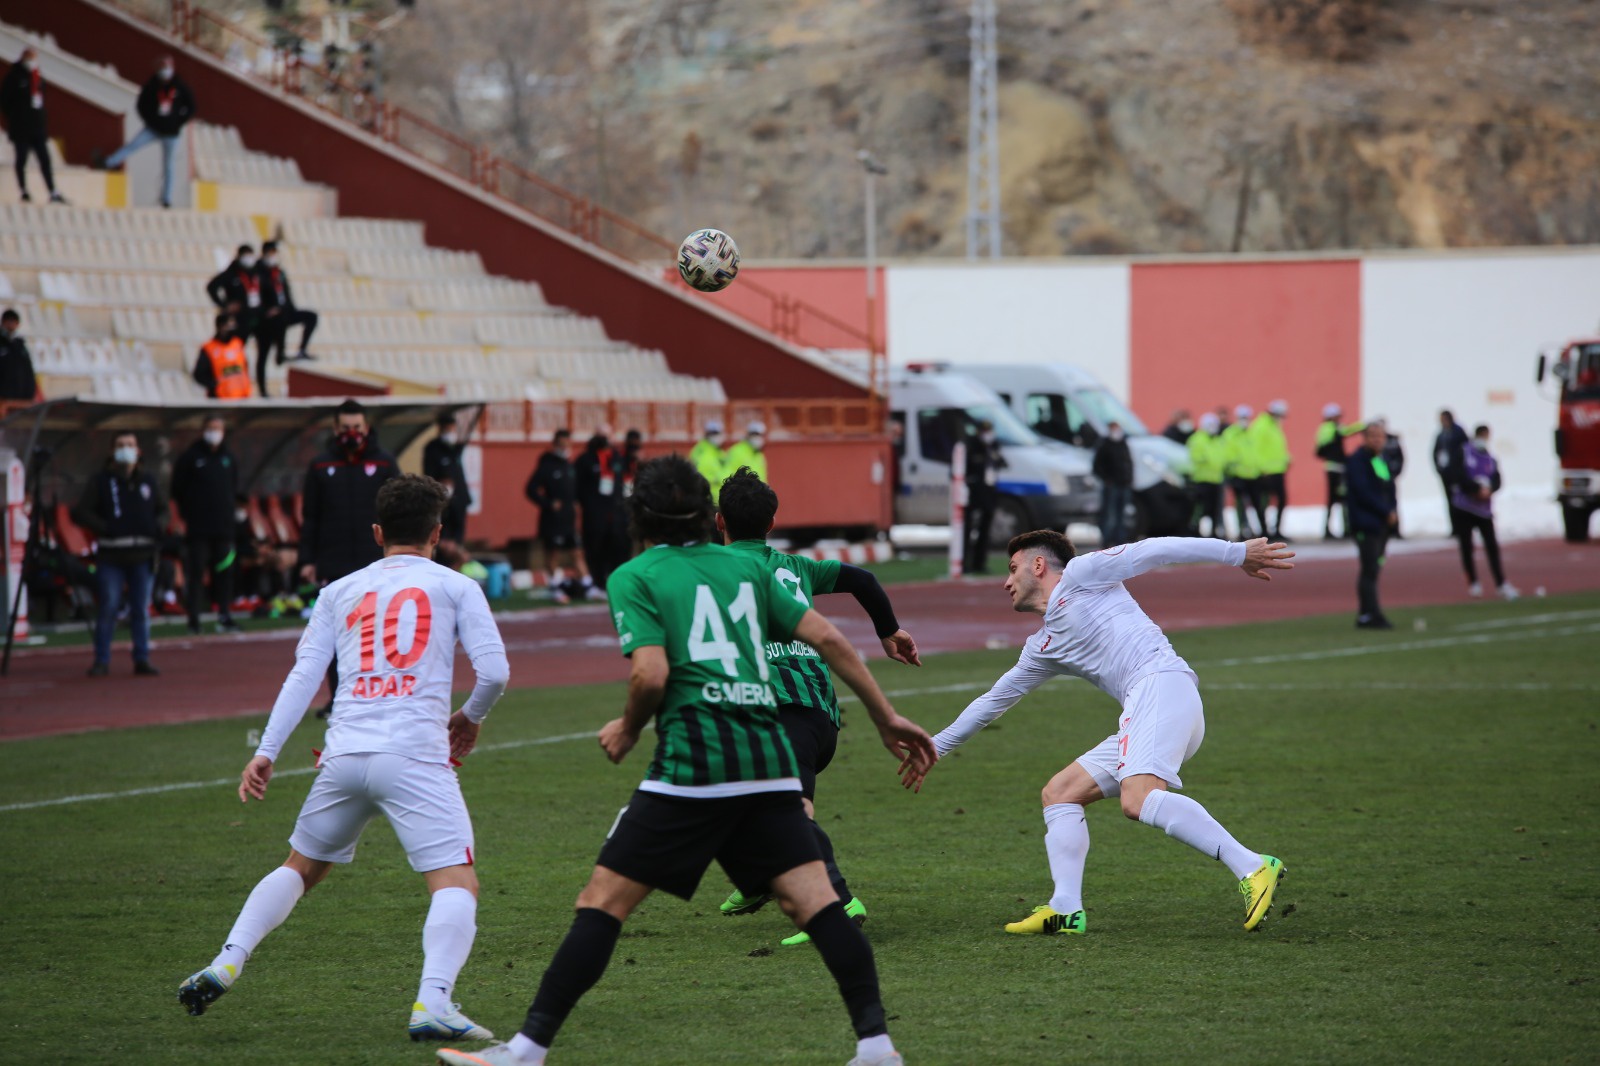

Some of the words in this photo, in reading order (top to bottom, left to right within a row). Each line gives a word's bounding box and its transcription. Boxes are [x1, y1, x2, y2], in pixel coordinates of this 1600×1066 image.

[346, 587, 431, 672] 10
[688, 582, 770, 682] 41
[352, 675, 417, 699] ADAR
[1043, 910, 1083, 933] NIKE
